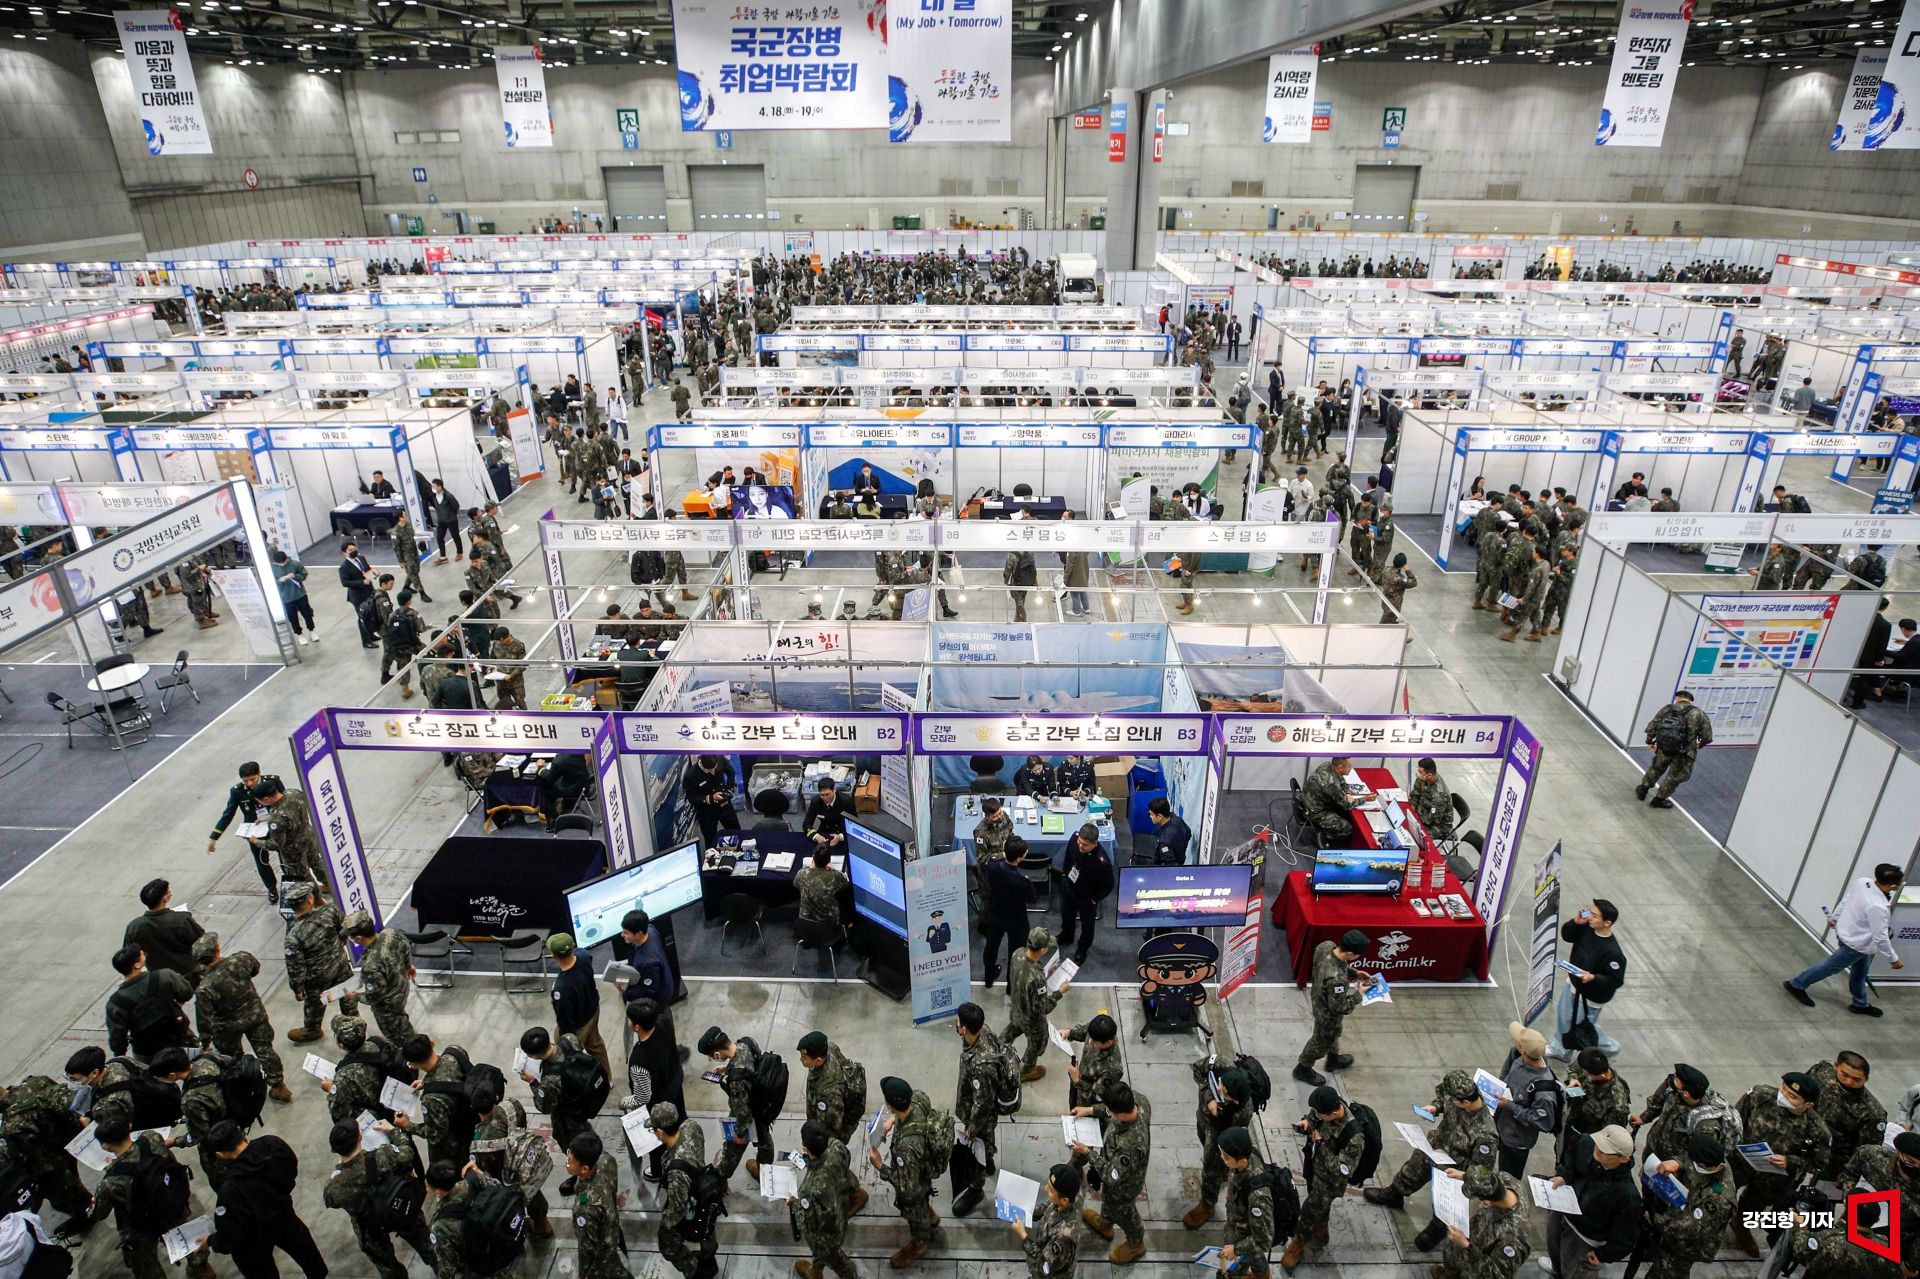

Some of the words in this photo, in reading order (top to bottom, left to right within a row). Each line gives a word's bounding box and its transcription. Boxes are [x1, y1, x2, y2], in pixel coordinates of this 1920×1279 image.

[896, 16, 915, 29] (My
[917, 16, 937, 28] Job
[948, 15, 1003, 28] Tomorrow)
[730, 26, 842, 58] 국군장병
[1628, 36, 1672, 53] 현직자
[135, 40, 175, 56] 마음과
[146, 58, 173, 73] 뜻과
[1630, 55, 1661, 71] 그룹
[150, 74, 177, 90] 힘을
[514, 77, 528, 88] 1:1
[719, 62, 859, 94] 취업박람회
[970, 70, 991, 86] 국방
[1273, 70, 1312, 84] AI역량
[1621, 72, 1664, 89] 멘토링
[503, 90, 543, 103] 컨설팅관
[1273, 86, 1309, 99] 검사관
[141, 91, 195, 107] 다하여!!!
[758, 106, 769, 117] 4.
[625, 134, 635, 142] 10
[719, 132, 730, 142] 10
[1385, 135, 1399, 145] 10B
[781, 432, 797, 440] C53
[930, 432, 946, 440] C54
[1082, 432, 1097, 440] C55
[1231, 433, 1247, 441] C56
[1512, 434, 1541, 443] GROUP
[1582, 437, 1597, 445] C69
[1729, 438, 1744, 447] C70
[133, 514, 201, 556] 국방전직교육원
[1709, 603, 1737, 612] 2023년
[1737, 603, 1761, 612] 전반기
[1761, 603, 1791, 612] 국군장병
[777, 635, 814, 650] 해군의
[818, 632, 840, 650] 힘!
[348, 719, 366, 729] 간부
[634, 724, 653, 733] 간부
[933, 725, 952, 734] 간부
[1234, 725, 1253, 734] 간부
[345, 728, 372, 738] 모집관
[445, 722, 479, 740] 장교
[523, 723, 558, 740] 안내
[580, 727, 596, 739] B1
[741, 725, 777, 741] 간부
[821, 725, 857, 741] 안내
[876, 728, 896, 739] B2
[1006, 726, 1040, 742] 공군
[1046, 726, 1081, 742] 간부
[1126, 725, 1163, 742] 안내
[1177, 729, 1197, 740] B3
[1292, 726, 1345, 743] 해병대
[1350, 726, 1385, 743] 간부
[1430, 728, 1466, 745] 안내
[632, 732, 659, 742] 모집관
[929, 733, 956, 743] 모집관
[1229, 734, 1256, 744] 모집관
[1475, 731, 1495, 743] B4
[918, 959, 943, 972] NEED
[944, 952, 967, 966] YOU!
